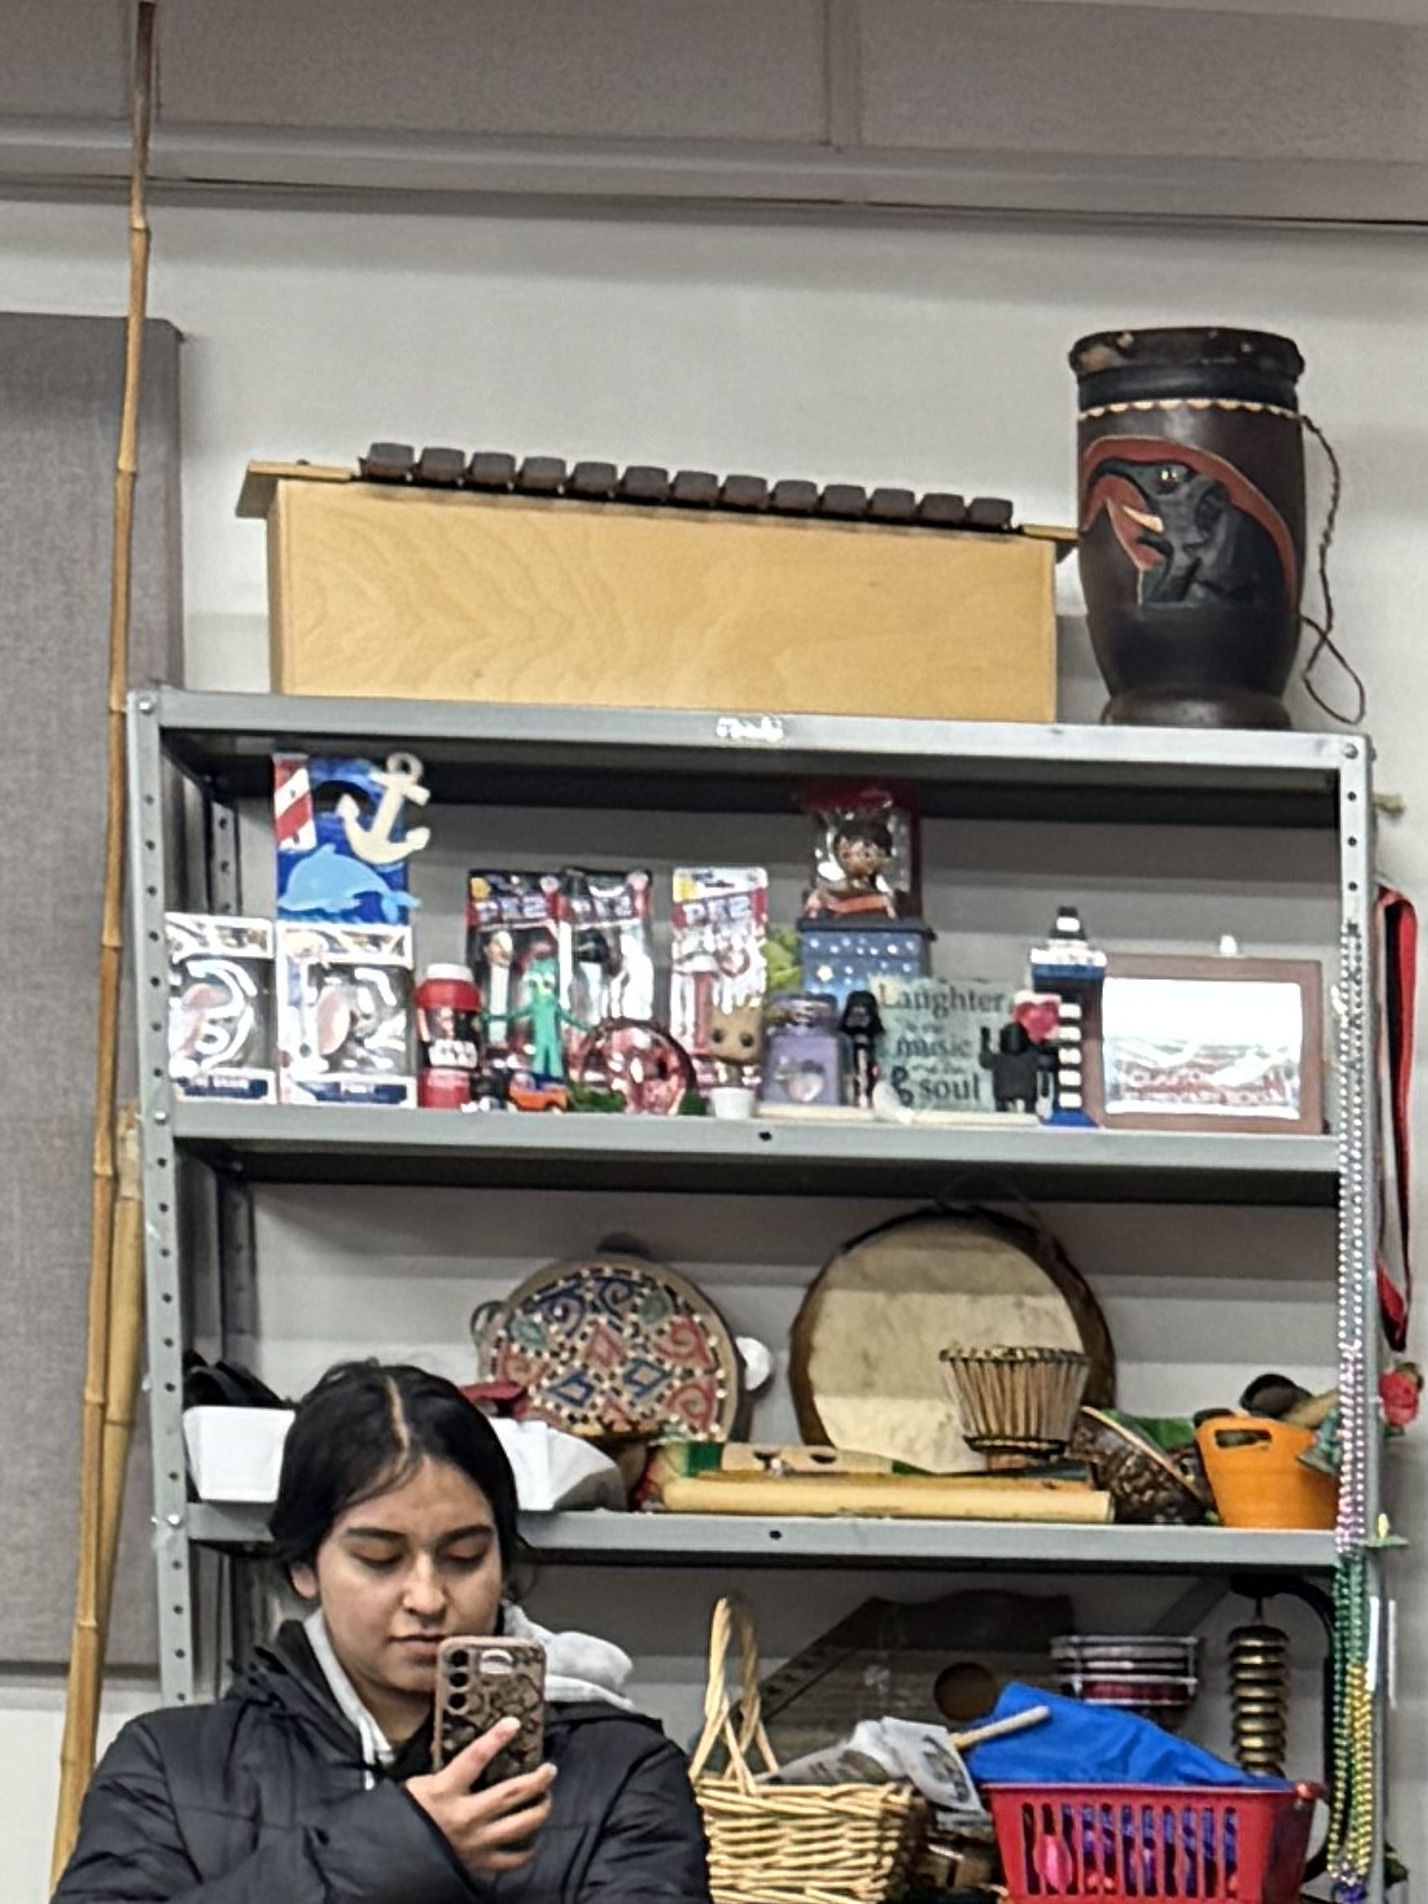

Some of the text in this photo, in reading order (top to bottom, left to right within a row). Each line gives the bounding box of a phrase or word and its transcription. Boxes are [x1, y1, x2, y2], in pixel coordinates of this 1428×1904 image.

[878, 981, 1005, 1018] Laughter
[896, 1036, 973, 1057] music
[919, 1072, 981, 1100] soul
